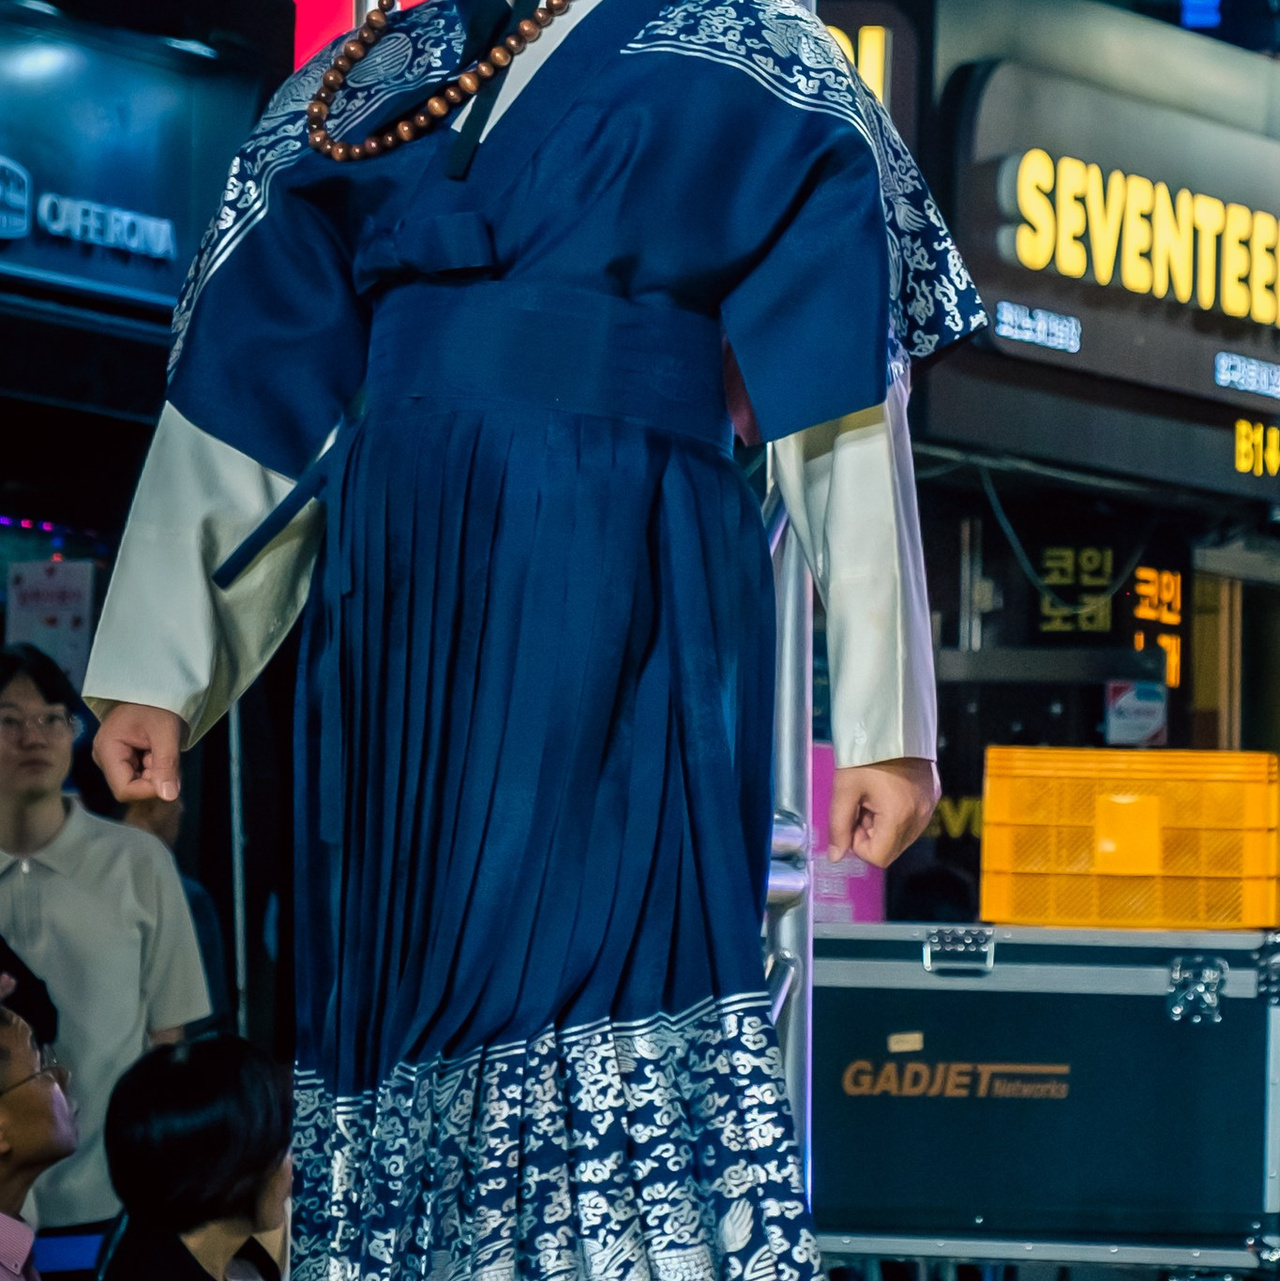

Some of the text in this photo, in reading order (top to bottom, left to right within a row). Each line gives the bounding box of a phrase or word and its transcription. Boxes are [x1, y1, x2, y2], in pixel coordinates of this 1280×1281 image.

[1235, 419, 1264, 477] B1
[1042, 547, 1113, 586] 코인
[1134, 566, 1181, 625] 코인
[842, 1060, 996, 1097] GADJET
